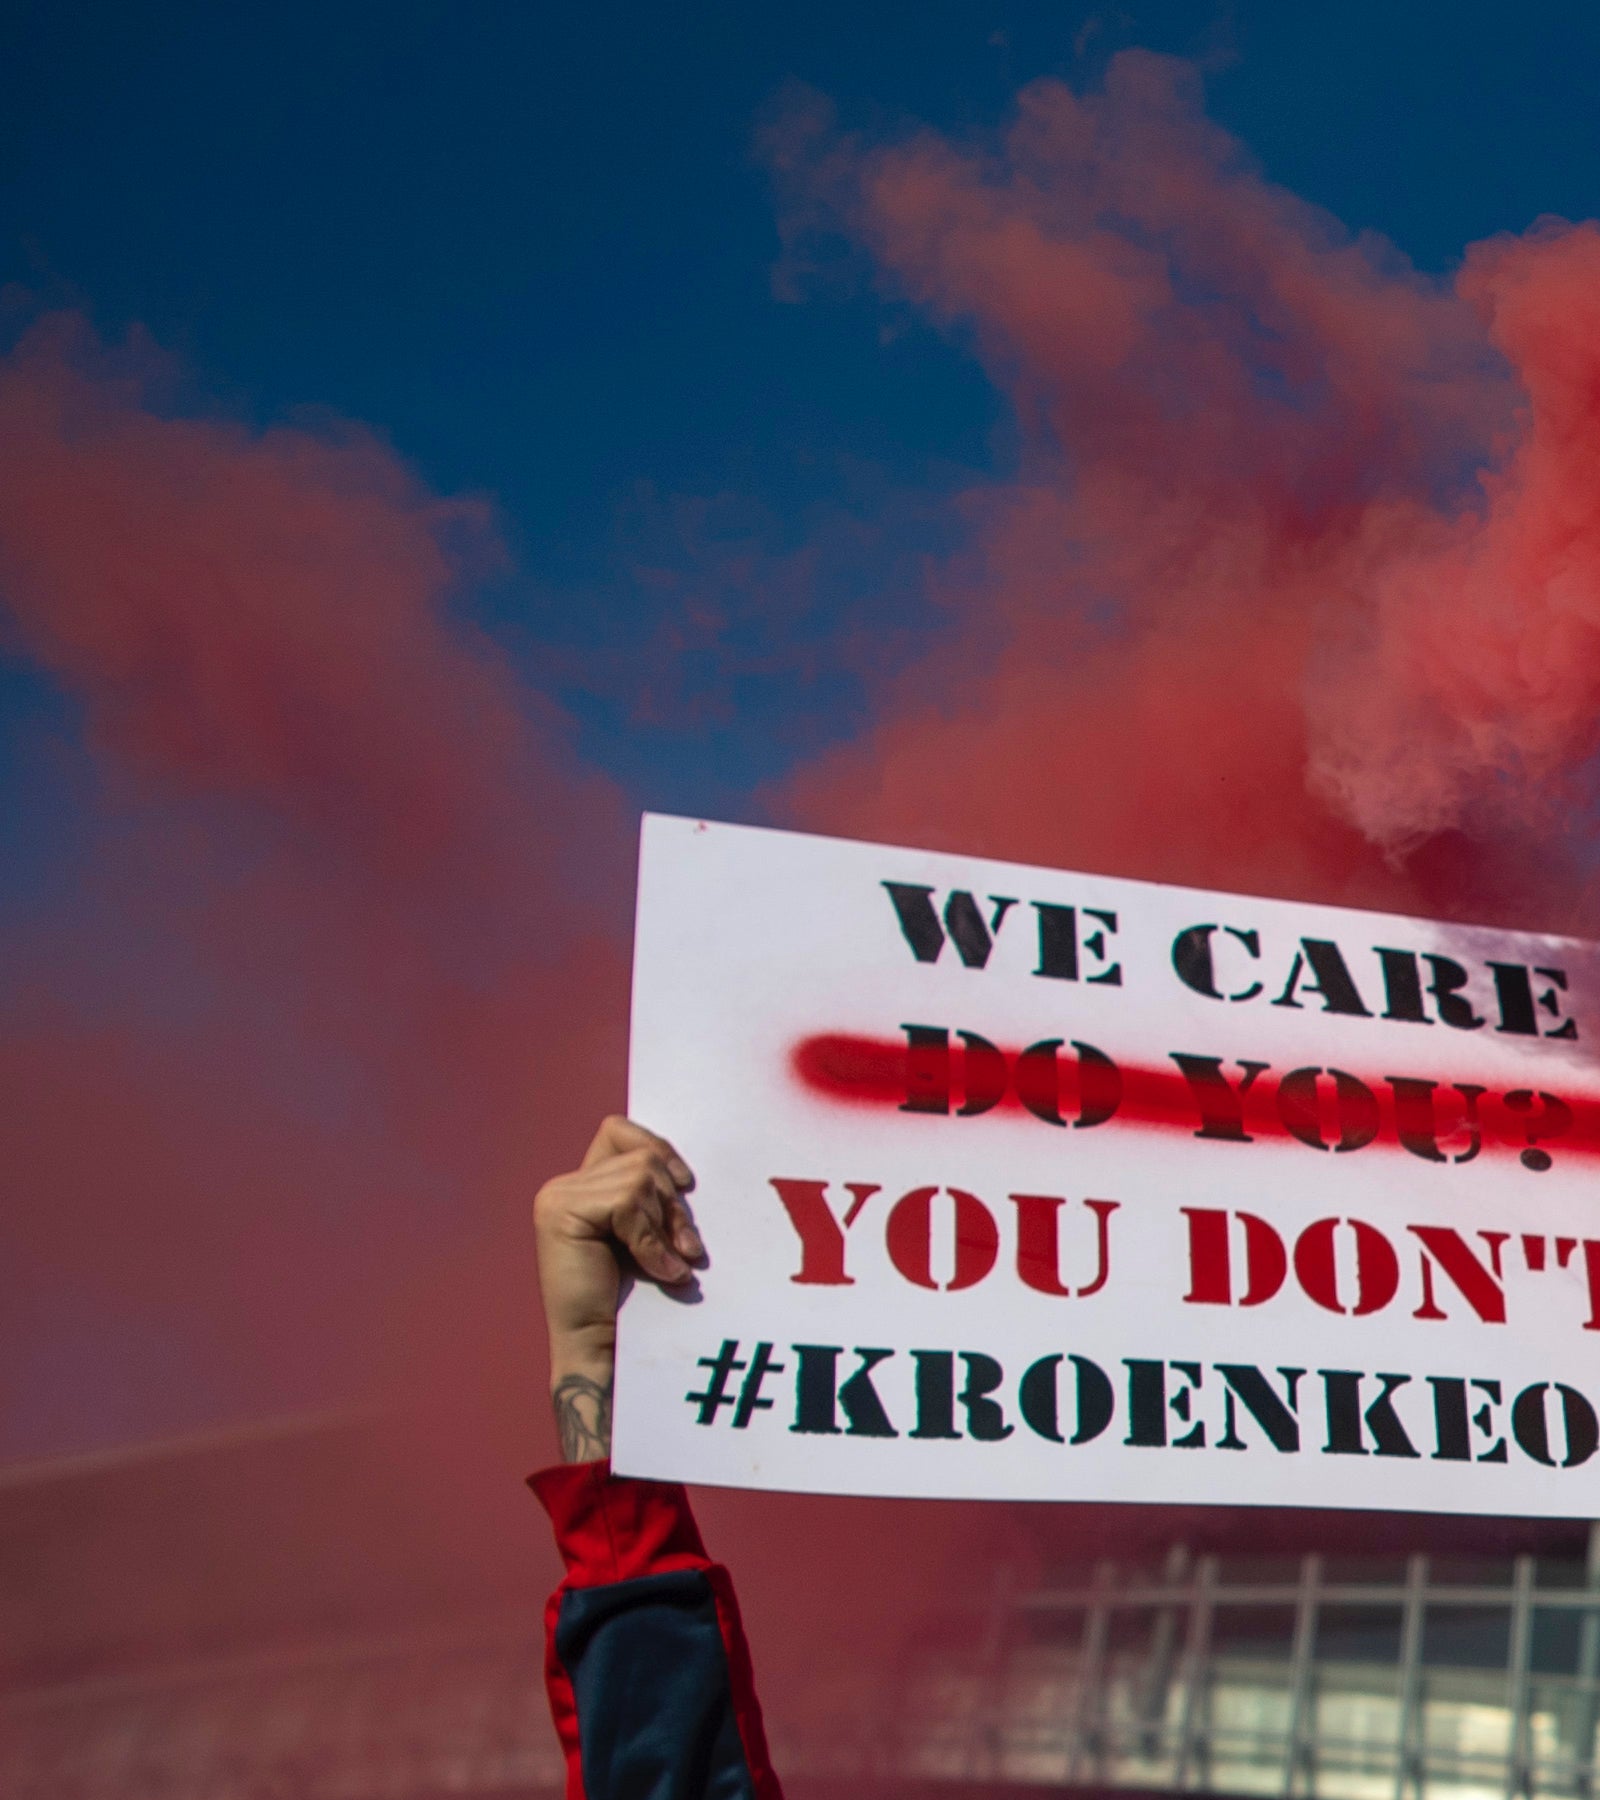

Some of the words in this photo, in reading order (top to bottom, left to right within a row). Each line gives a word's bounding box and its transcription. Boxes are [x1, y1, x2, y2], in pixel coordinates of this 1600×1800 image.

[880, 878, 1123, 987] WE
[1170, 923, 1578, 1042] CARE
[898, 1024, 1123, 1130] DO
[1168, 1051, 1576, 1173] YOU?
[768, 1177, 1121, 1301] YOU
